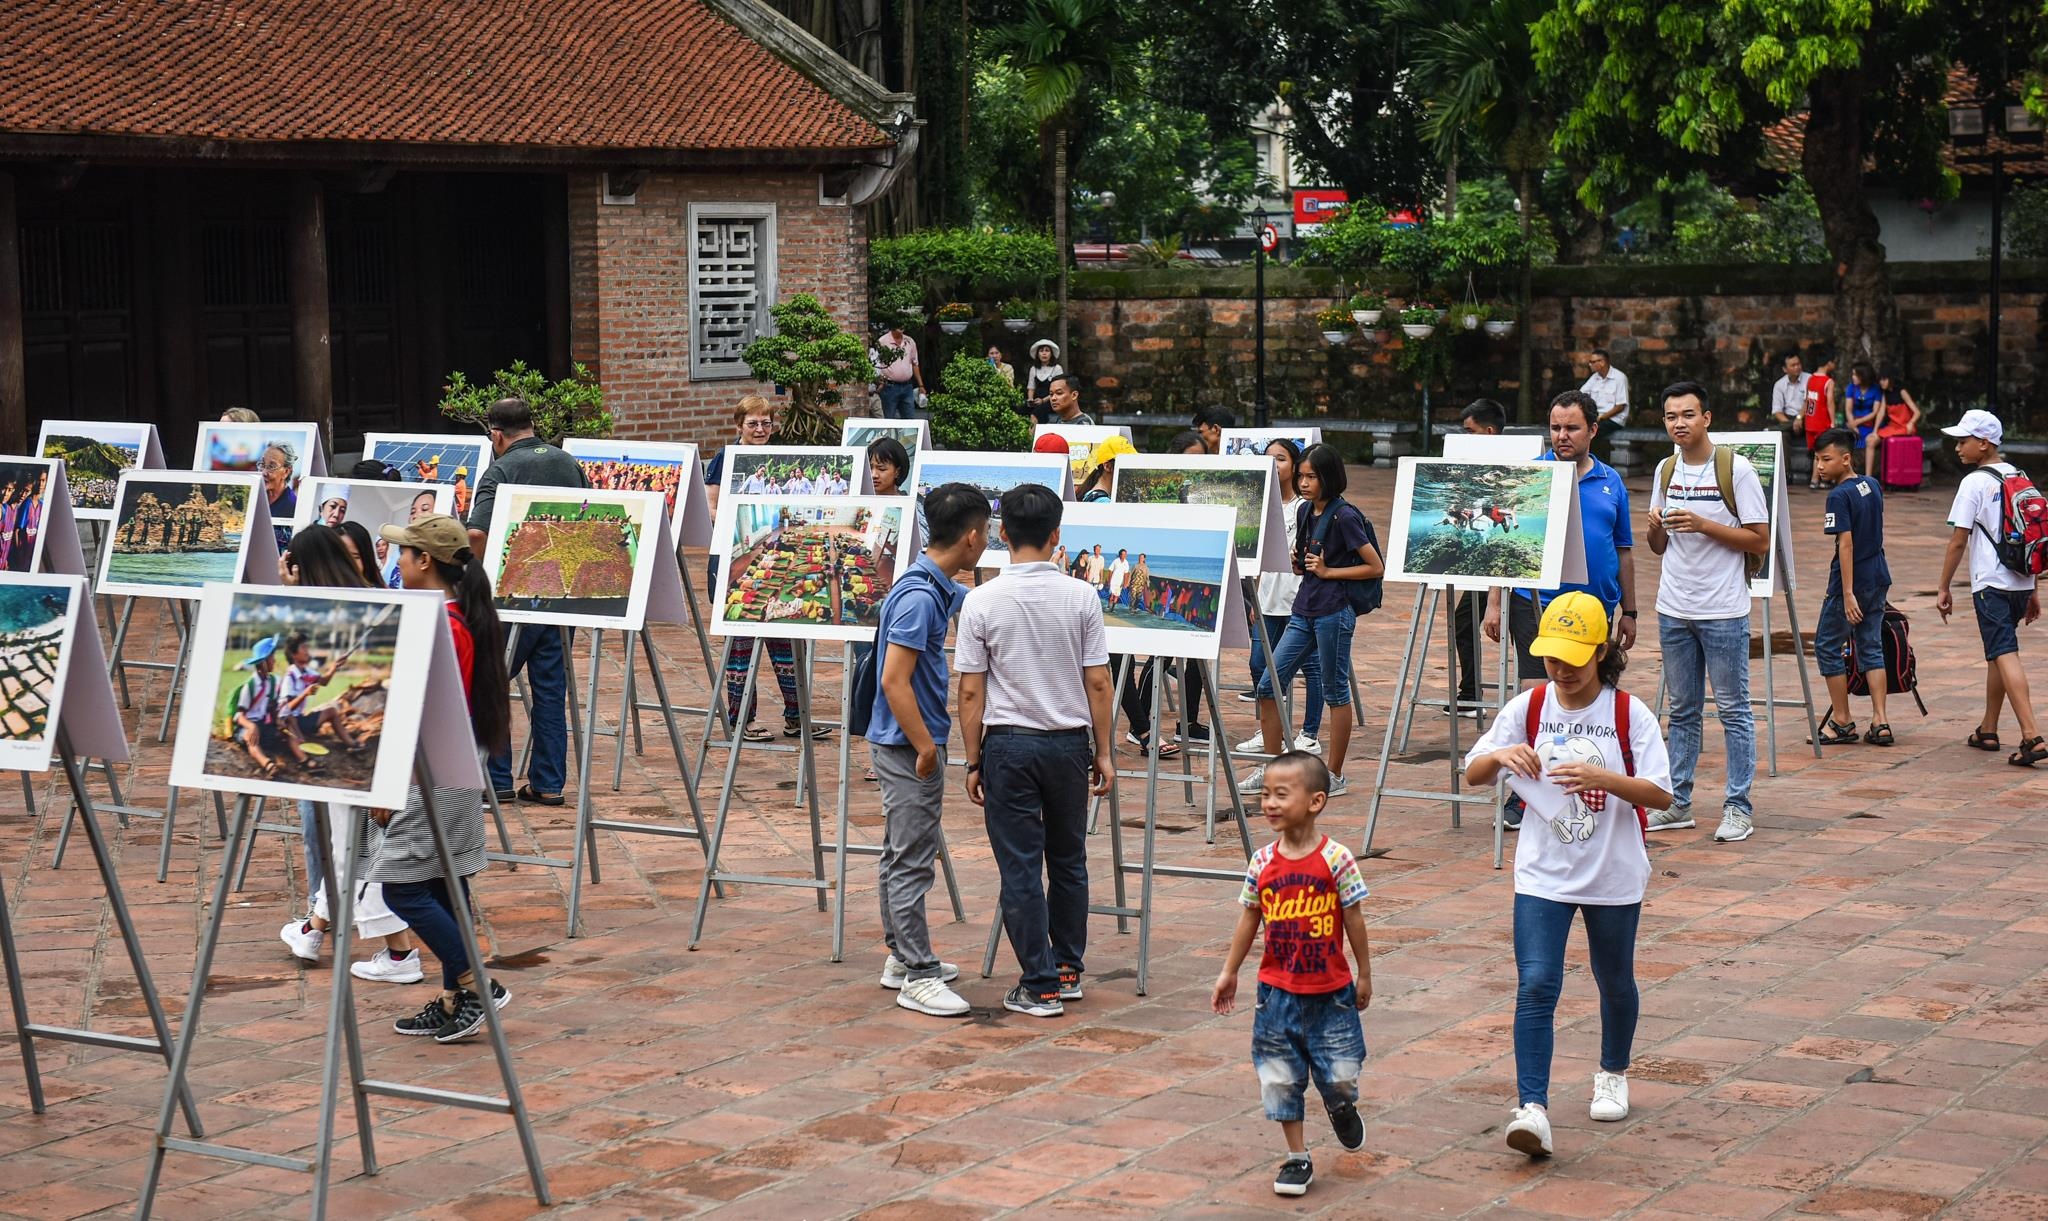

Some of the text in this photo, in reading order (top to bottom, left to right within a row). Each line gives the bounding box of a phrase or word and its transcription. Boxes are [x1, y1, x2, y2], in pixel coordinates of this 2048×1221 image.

[1567, 722, 1583, 735] TO
[1586, 725, 1617, 739] WORK
[1261, 885, 1337, 925] Station
[1309, 915, 1334, 938] 38
[1302, 942, 1326, 958] OF
[1328, 940, 1337, 955] A
[1277, 955, 1327, 974] TRAIN
